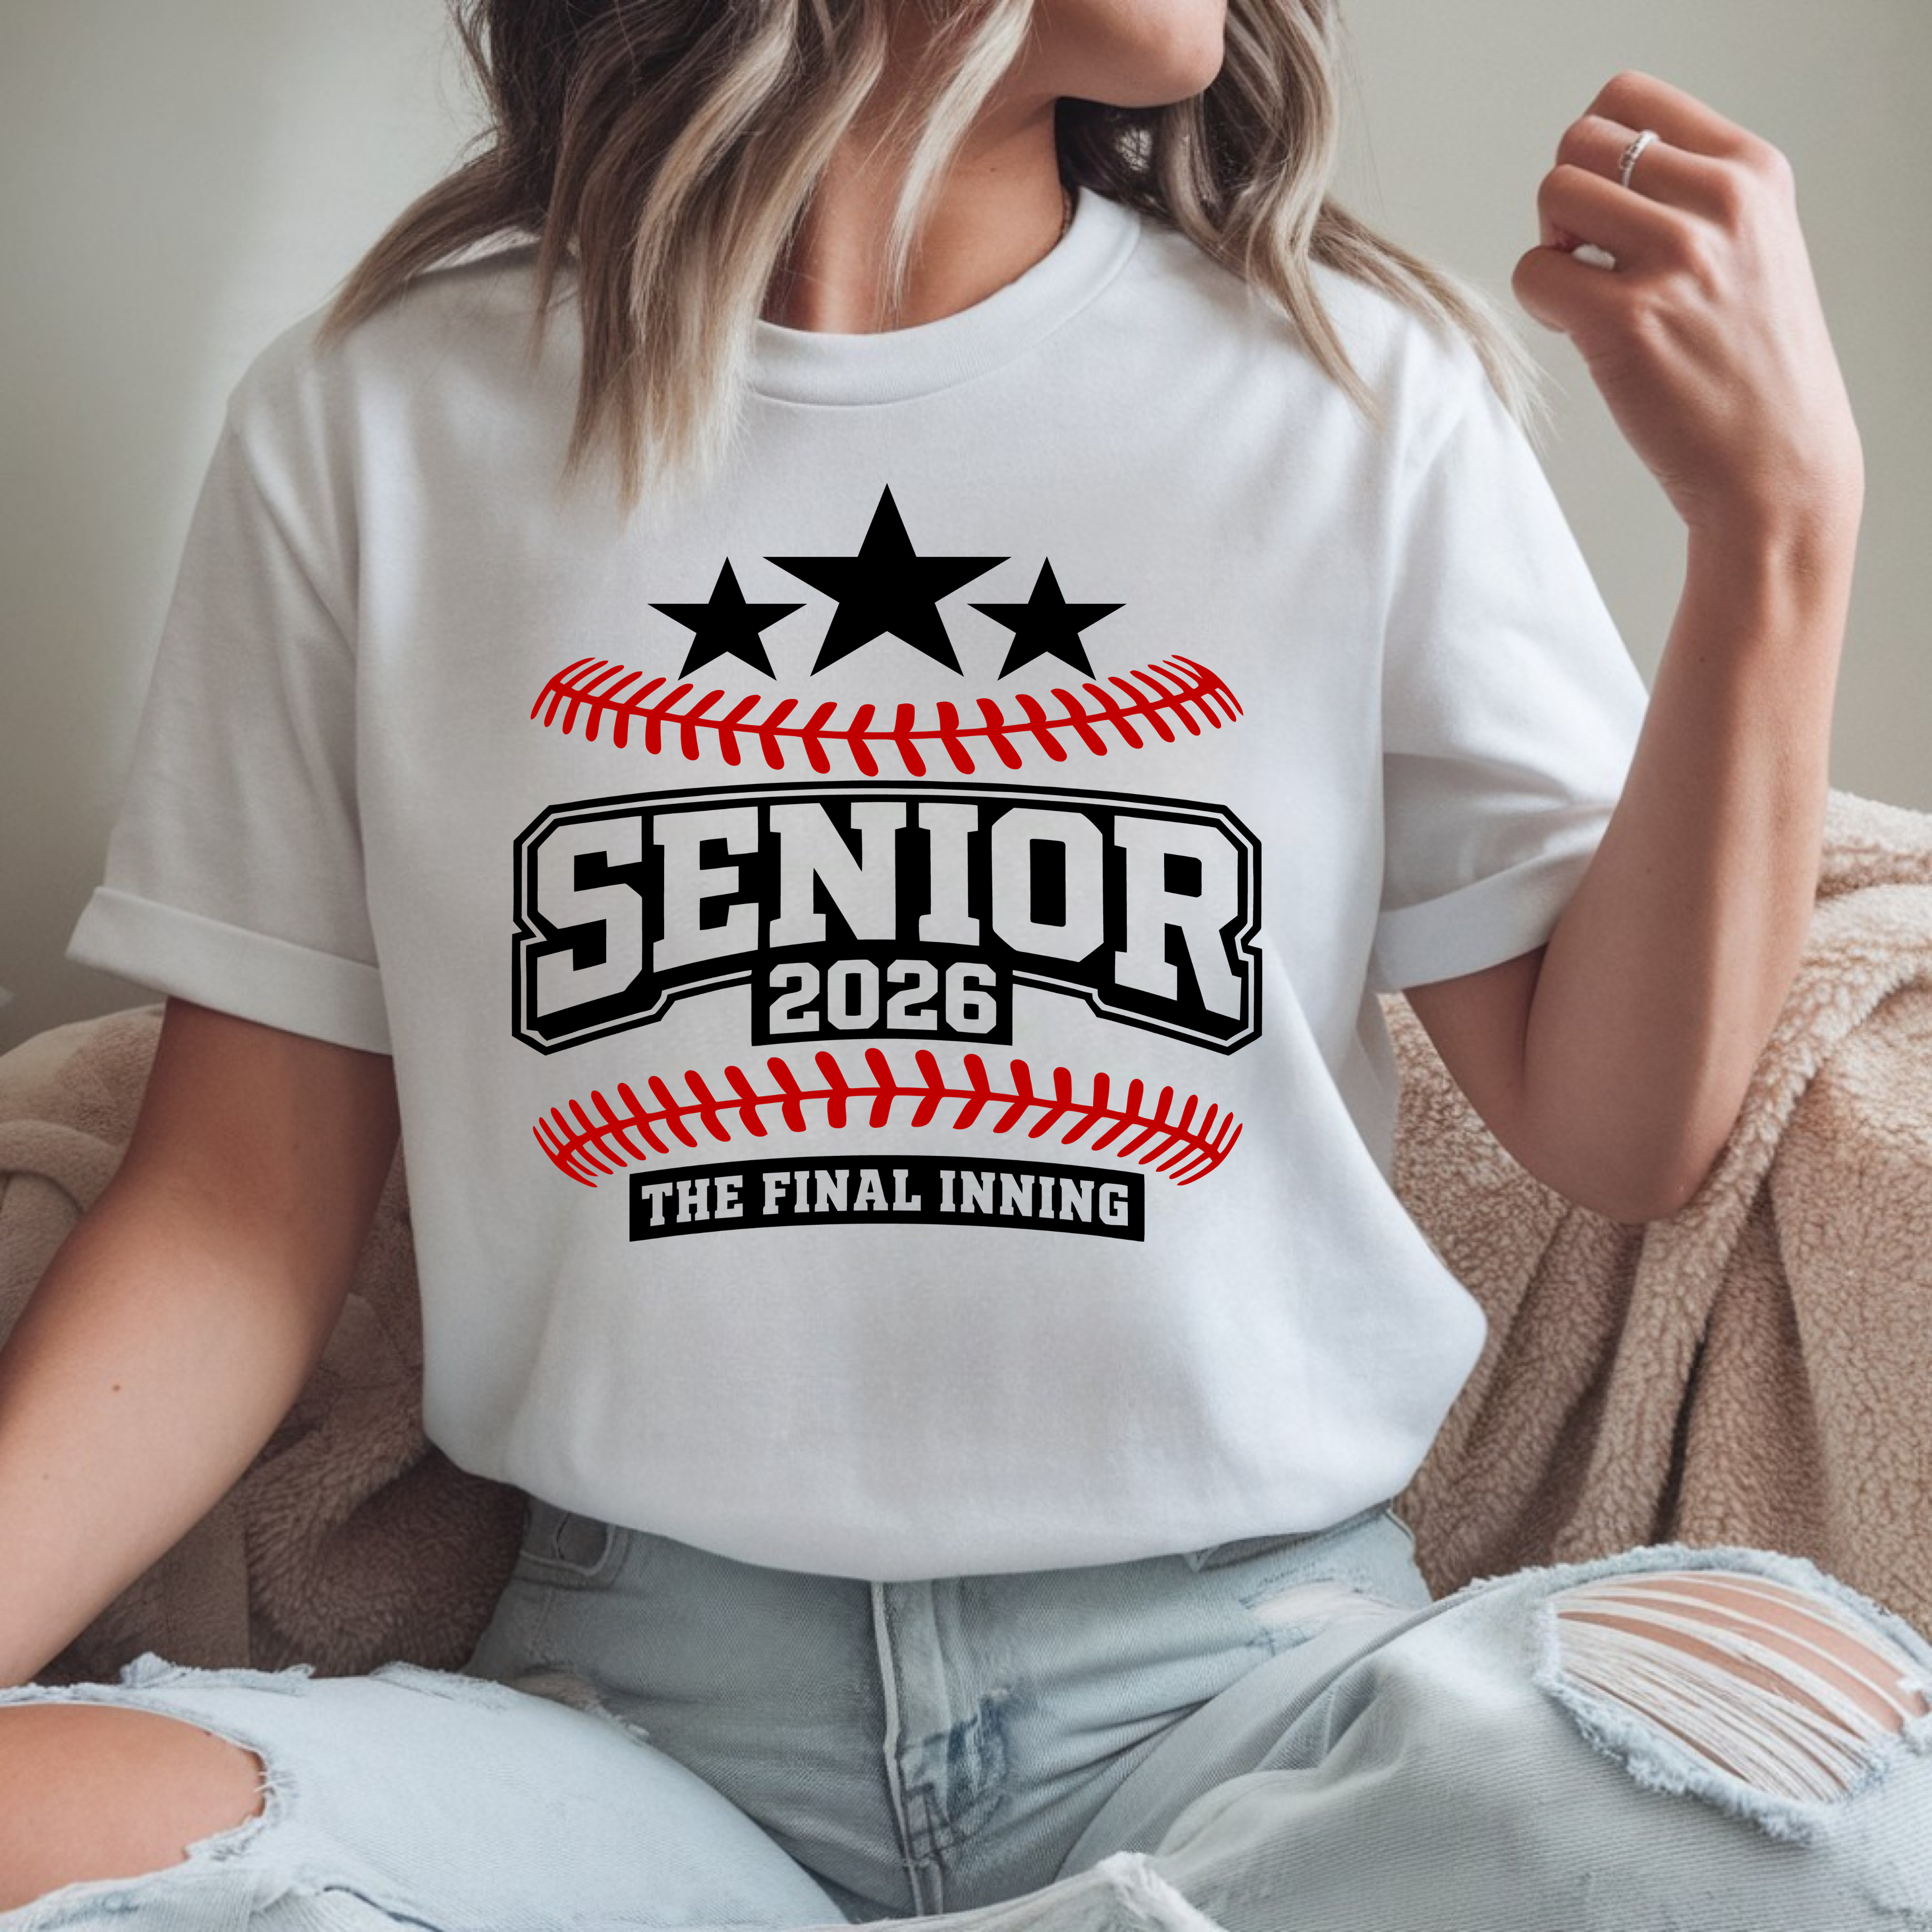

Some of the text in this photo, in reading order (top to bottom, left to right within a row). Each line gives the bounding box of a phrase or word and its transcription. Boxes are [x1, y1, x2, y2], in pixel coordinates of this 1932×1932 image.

[537, 802, 1241, 1020] SENIOR
[770, 960, 996, 1034] 2026
[642, 1169, 1128, 1226] THE FINAL INNING
